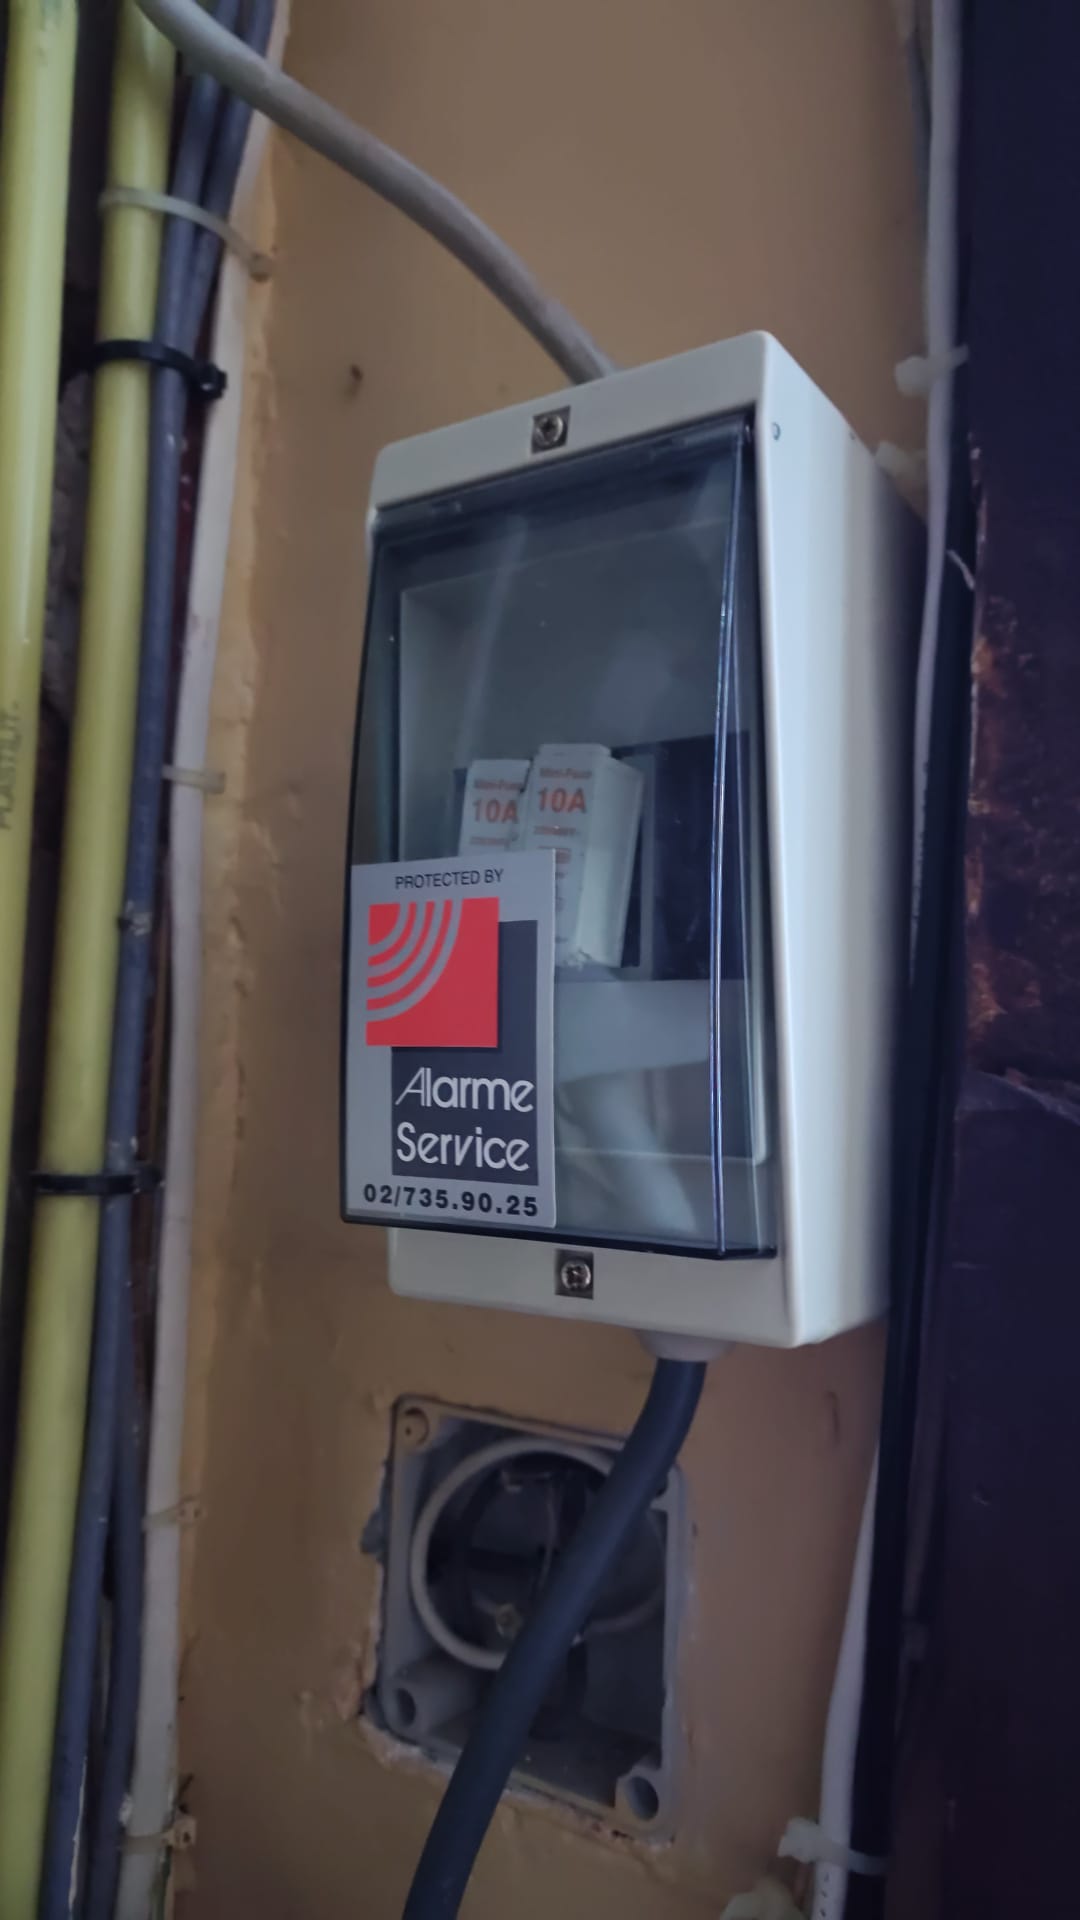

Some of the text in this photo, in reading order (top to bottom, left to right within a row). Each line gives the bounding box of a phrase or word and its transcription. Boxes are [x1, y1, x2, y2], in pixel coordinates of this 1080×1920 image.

[473, 798, 518, 824] 10A
[538, 787, 586, 814] 10A
[395, 868, 504, 889] PROTECTED BY
[395, 1068, 533, 1113] Alarme
[396, 1122, 530, 1172] Service
[364, 1184, 538, 1217] 02/735.90.25
